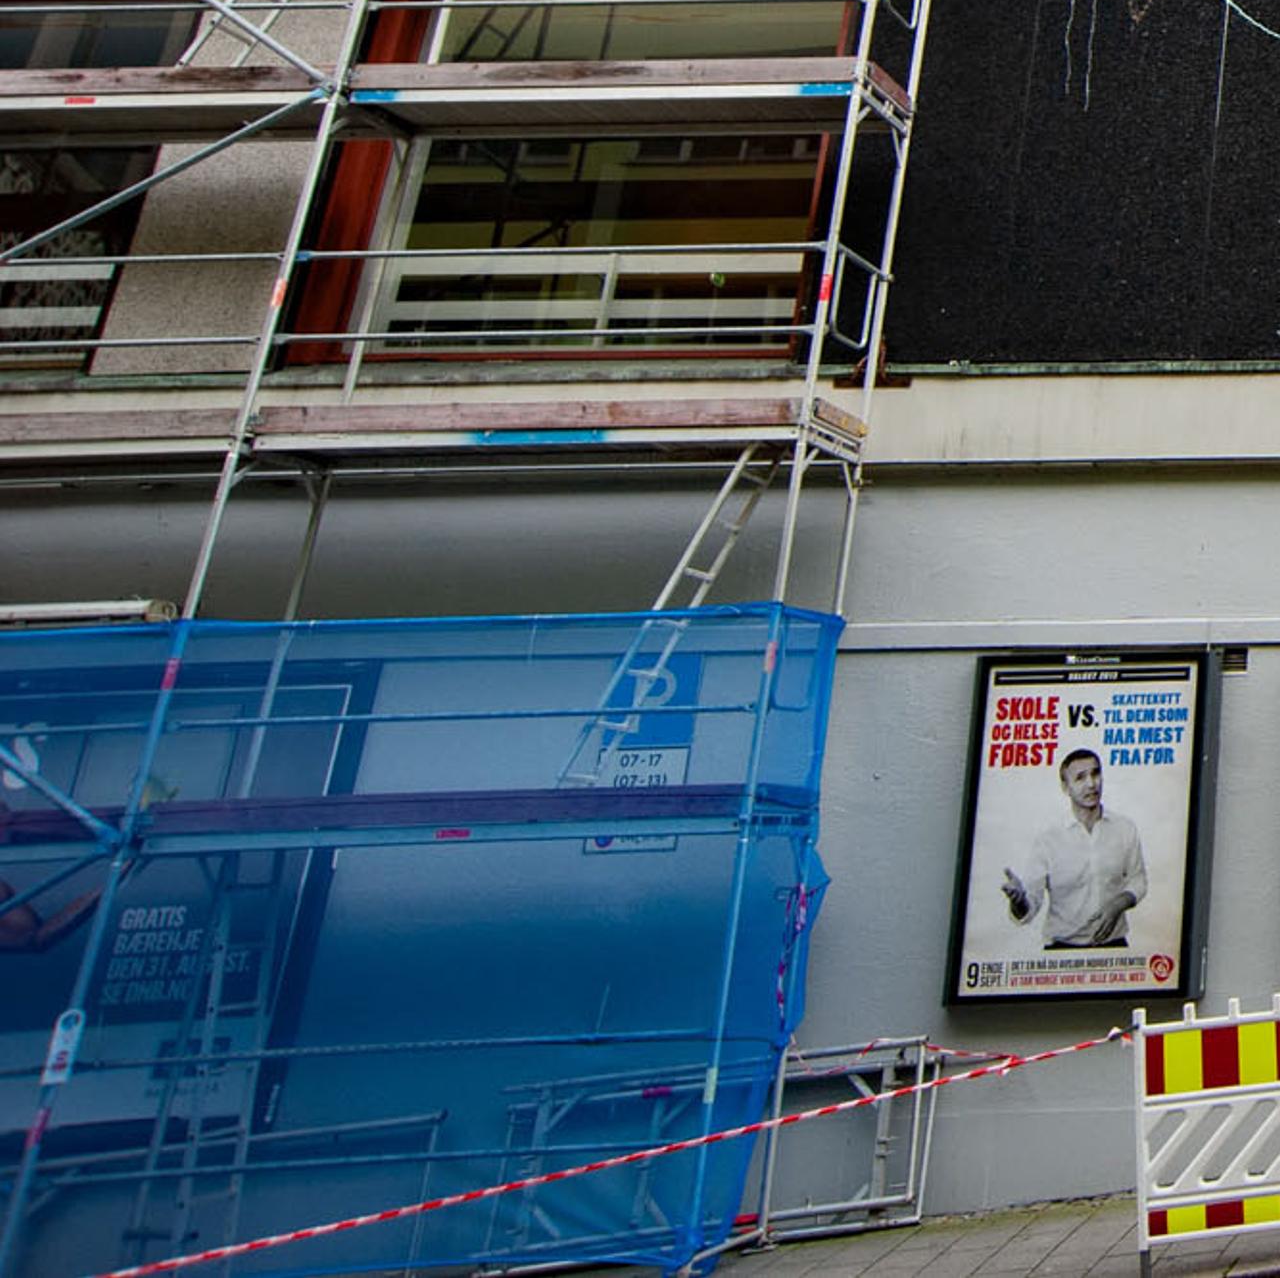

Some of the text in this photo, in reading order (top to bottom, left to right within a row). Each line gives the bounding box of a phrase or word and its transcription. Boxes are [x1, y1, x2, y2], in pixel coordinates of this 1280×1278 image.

[995, 696, 1060, 721] SKOLE
[1112, 693, 1182, 706] SKATTEKUTT
[1068, 704, 1099, 728] VS.
[1103, 707, 1188, 724] TIL DEM SOM
[991, 723, 1060, 741] OG HELSE
[1103, 727, 1185, 745] HAR MEST
[988, 743, 1058, 769] FØRST
[1109, 748, 1175, 766] FRA FØR
[119, 906, 187, 929] GRATIS
[966, 962, 980, 988] 9
